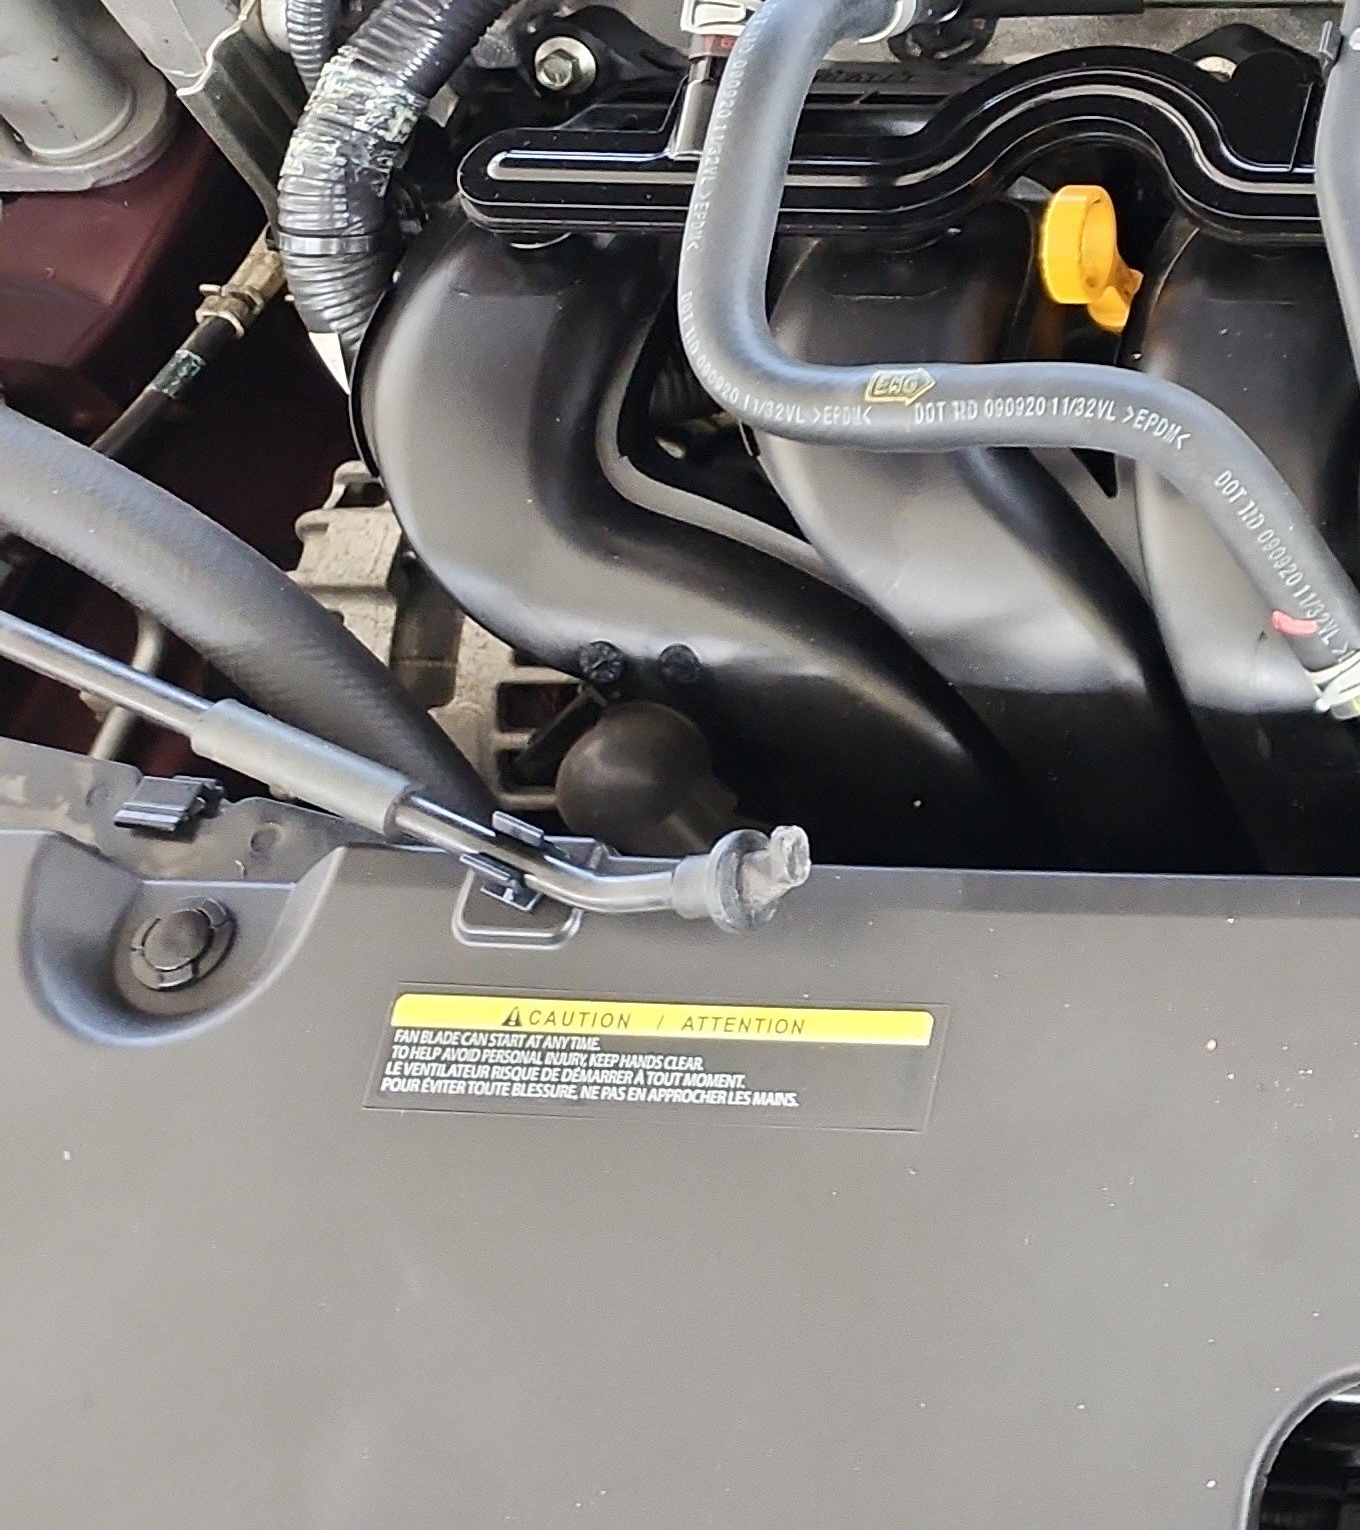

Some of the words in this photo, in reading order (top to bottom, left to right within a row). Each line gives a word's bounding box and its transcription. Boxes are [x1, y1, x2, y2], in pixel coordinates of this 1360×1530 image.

[913, 400, 944, 425] DOT
[984, 396, 1046, 418] 090920
[1051, 396, 1117, 422] 11/32VL
[1213, 469, 1248, 505] DOT
[1257, 529, 1304, 588] 090920
[528, 1008, 631, 1030] CAUTION
[655, 1015, 664, 1030] /
[680, 1015, 806, 1037] ATTENTION
[394, 1029, 419, 1044] FAN
[420, 1031, 461, 1046] BLADE
[460, 1032, 489, 1047] CAN
[489, 1033, 527, 1048] START
[525, 1035, 545, 1048] AT
[391, 1045, 410, 1060] TO
[409, 1047, 442, 1061] HELP
[441, 1048, 480, 1063] AVOID
[481, 1049, 543, 1065] PERSONAL
[545, 1052, 588, 1068] INJURY,
[589, 1053, 619, 1068] KEEP
[619, 1054, 663, 1070] HANDS
[663, 1056, 704, 1071] CLEAR.
[384, 1061, 403, 1076] LE
[403, 1062, 491, 1079] VENTILATEUR
[490, 1065, 540, 1082] RISQUE
[540, 1067, 561, 1082] DE
[561, 1065, 634, 1085] DÉMARRER
[633, 1068, 645, 1085] À
[646, 1071, 683, 1086] TOUT
[682, 1073, 746, 1089] MOMENT.
[380, 1077, 422, 1093] POUR
[421, 1076, 469, 1095] ÉVITER
[468, 1081, 512, 1096] TOUTE
[511, 1083, 579, 1100] BLESSURE,
[580, 1086, 600, 1100] NE
[600, 1086, 627, 1102] PAS
[627, 1088, 647, 1103] EN
[647, 1088, 728, 1105] APPROCHER
[727, 1091, 751, 1106] LES
[751, 1092, 800, 1108] MAINS.
